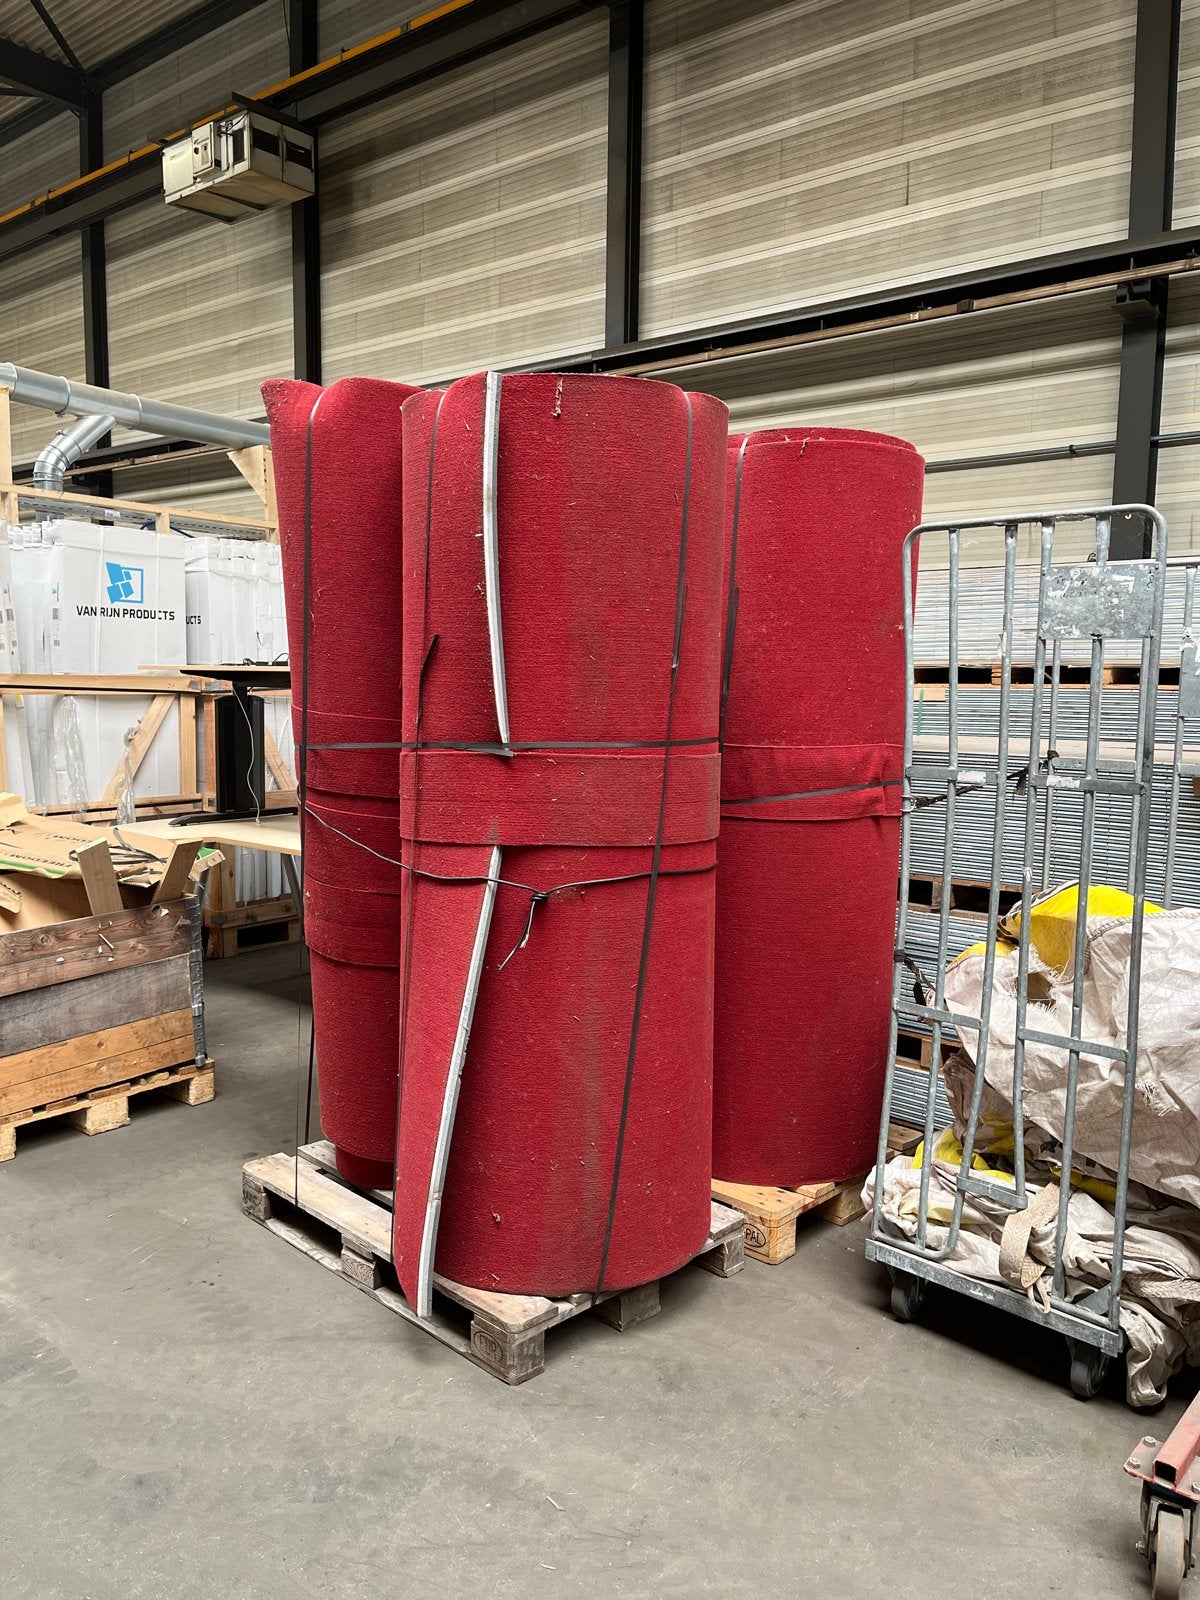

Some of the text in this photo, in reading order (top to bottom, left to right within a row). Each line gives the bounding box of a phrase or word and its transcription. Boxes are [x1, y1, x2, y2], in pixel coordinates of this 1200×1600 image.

[76, 605, 175, 621] VAN RIJN PRODUCTS
[185, 615, 202, 625] UCTS
